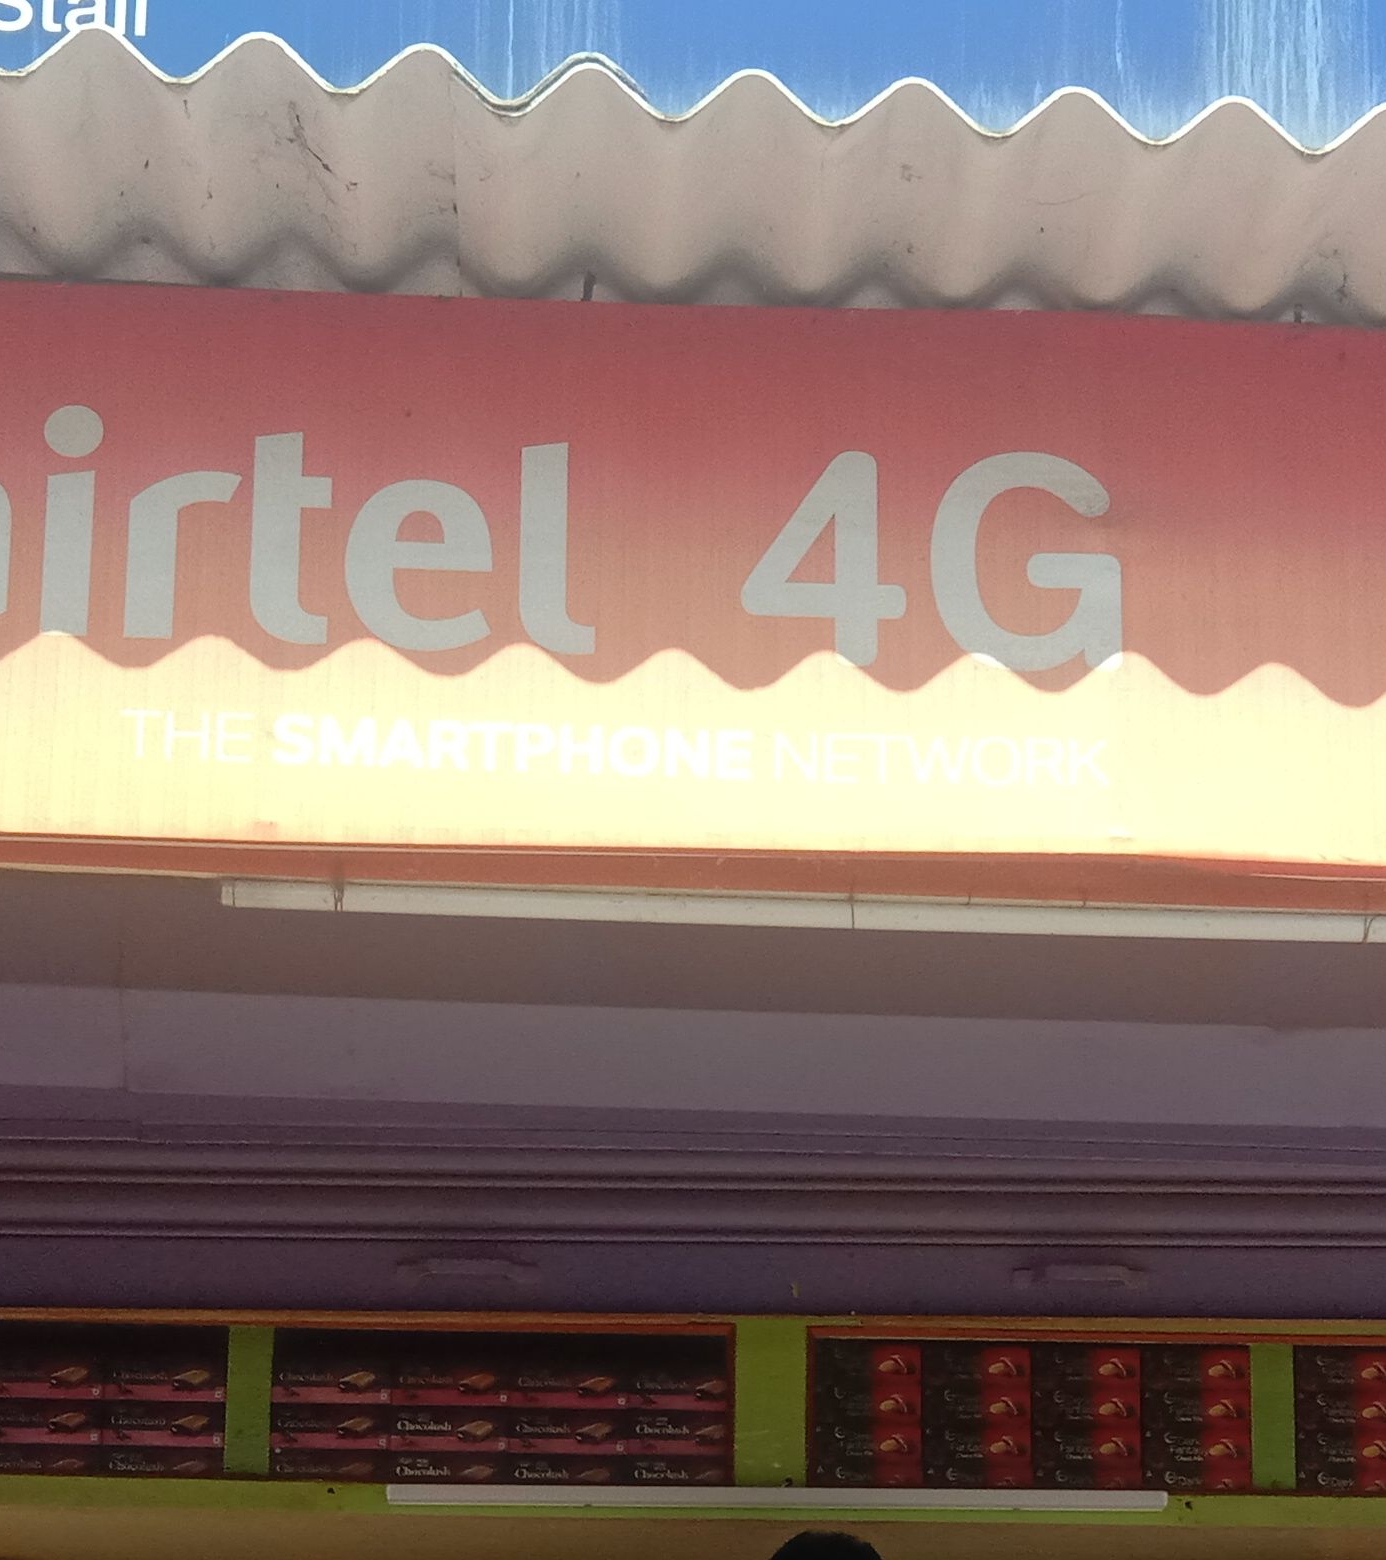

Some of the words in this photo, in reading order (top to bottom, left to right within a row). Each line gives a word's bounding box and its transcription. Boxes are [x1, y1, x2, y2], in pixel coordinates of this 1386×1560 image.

[740, 450, 1123, 672] 4G
[119, 708, 256, 763] THE
[272, 713, 753, 781] SMARTPHONE
[772, 731, 1112, 788] NETWORK
